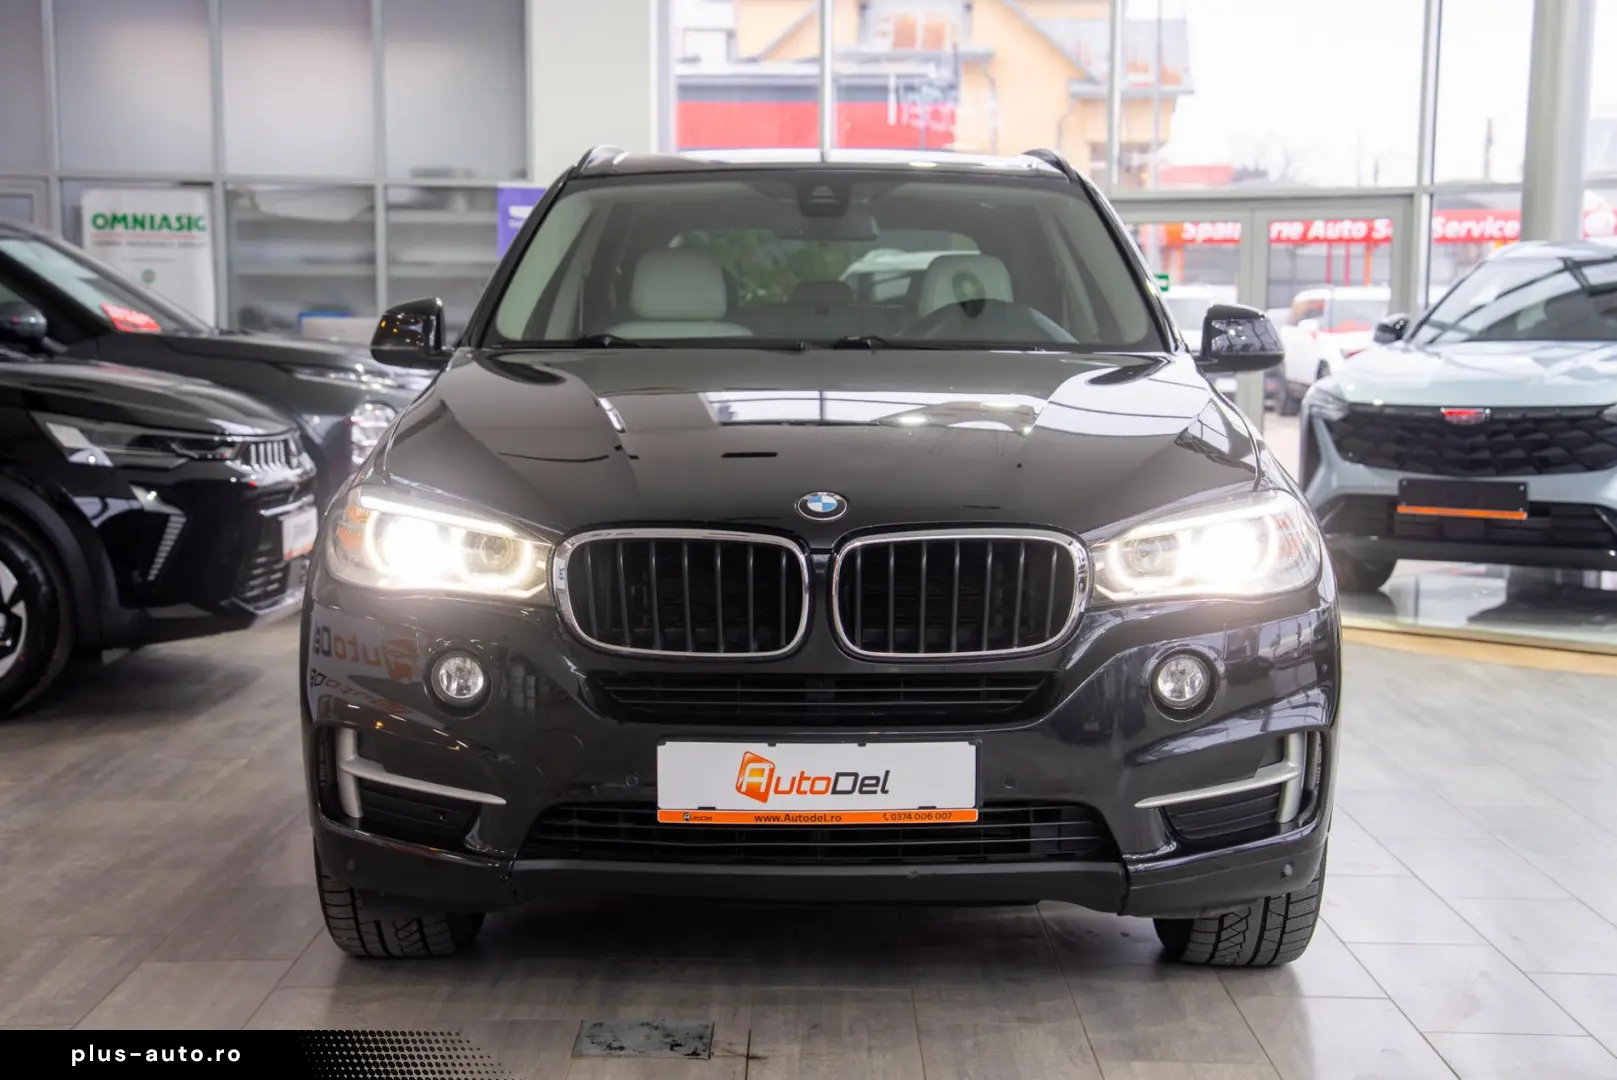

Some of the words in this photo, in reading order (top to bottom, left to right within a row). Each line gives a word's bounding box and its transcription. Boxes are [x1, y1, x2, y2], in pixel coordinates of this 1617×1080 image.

[1307, 219, 1368, 240] Auto
[1432, 215, 1520, 239] Service
[735, 750, 890, 803] AutoDel
[754, 813, 842, 823] www.Autodel.ro
[890, 813, 912, 821] 0374
[914, 812, 933, 820] 006
[934, 812, 953, 820] 007
